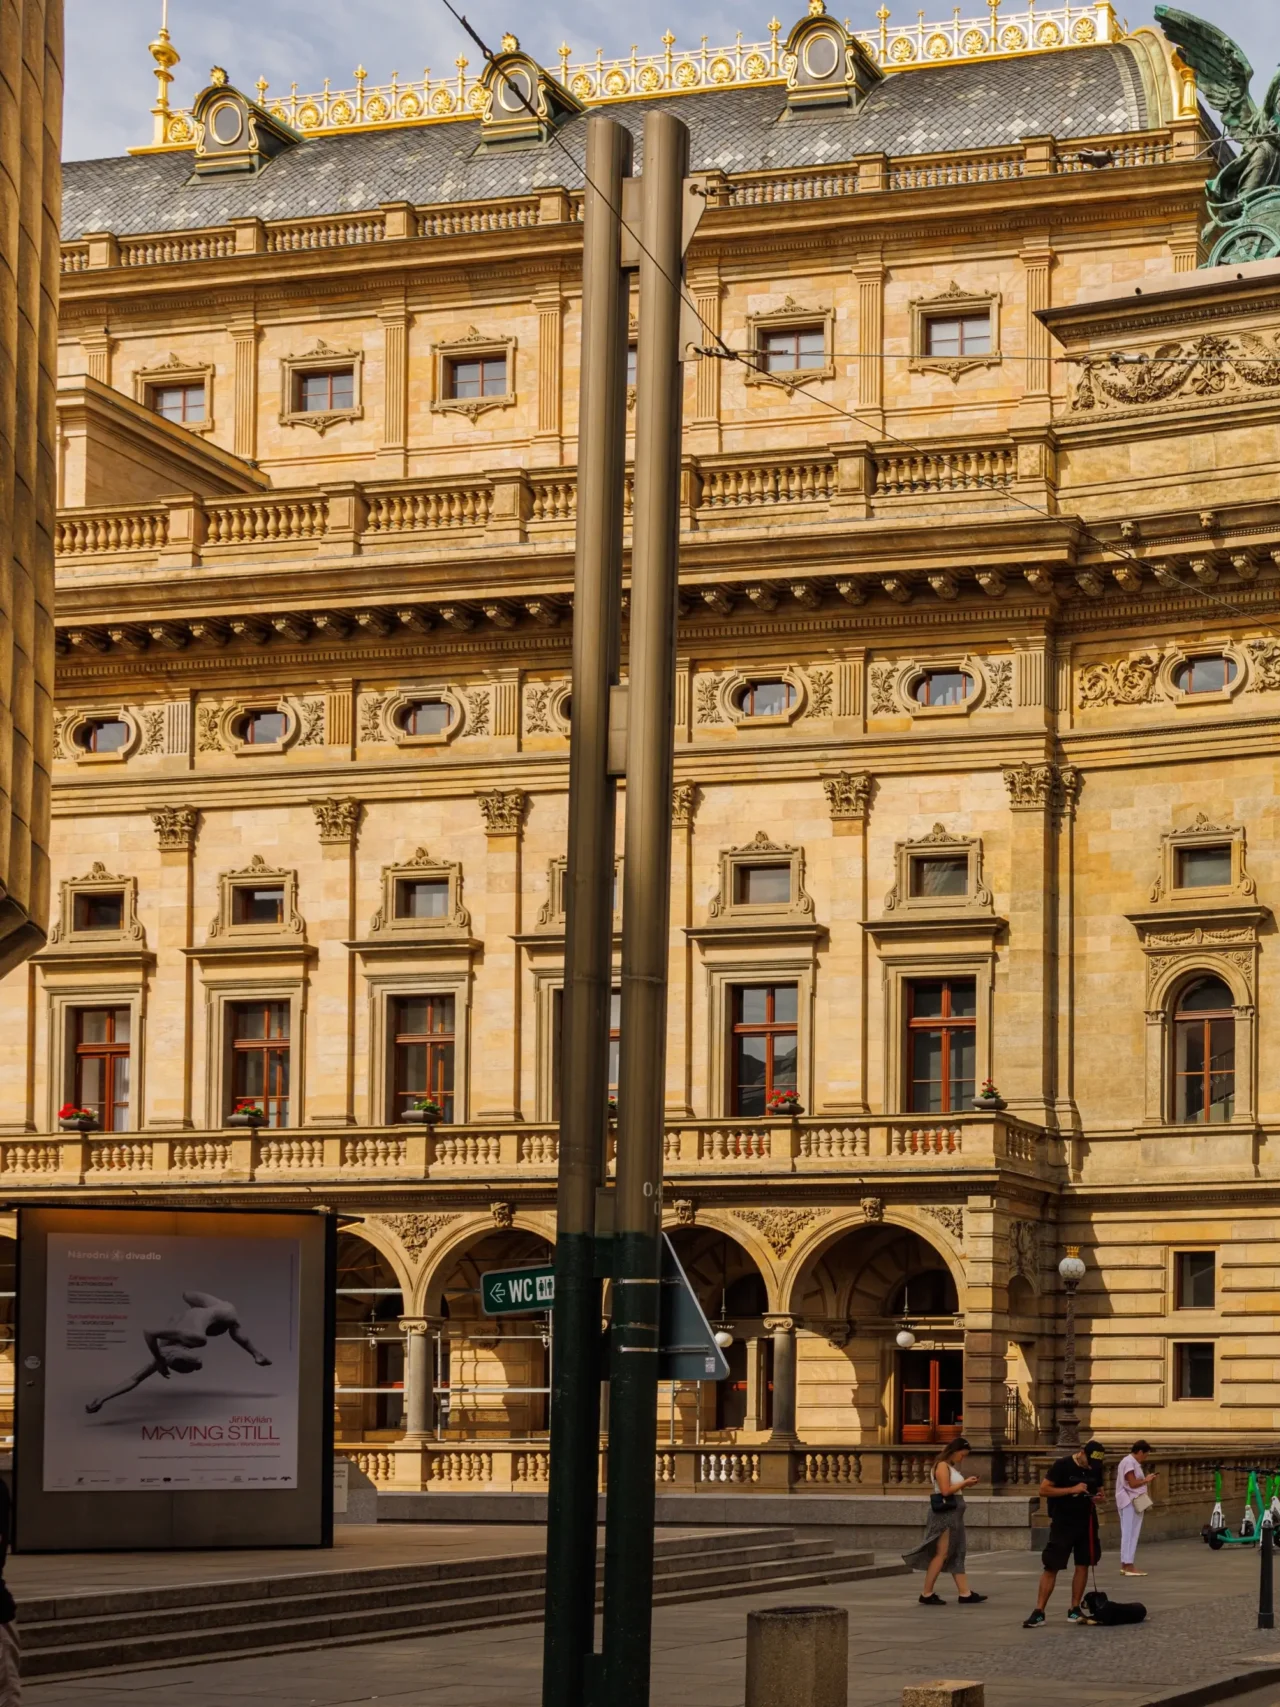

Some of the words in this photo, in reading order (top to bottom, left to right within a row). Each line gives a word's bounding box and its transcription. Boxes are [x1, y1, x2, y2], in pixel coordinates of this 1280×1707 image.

[125, 1251, 162, 1260] divadlo
[508, 1278, 533, 1303] WC
[229, 1416, 243, 1424] Jiří
[244, 1416, 272, 1425] Kylián
[228, 1425, 280, 1440] STILL
